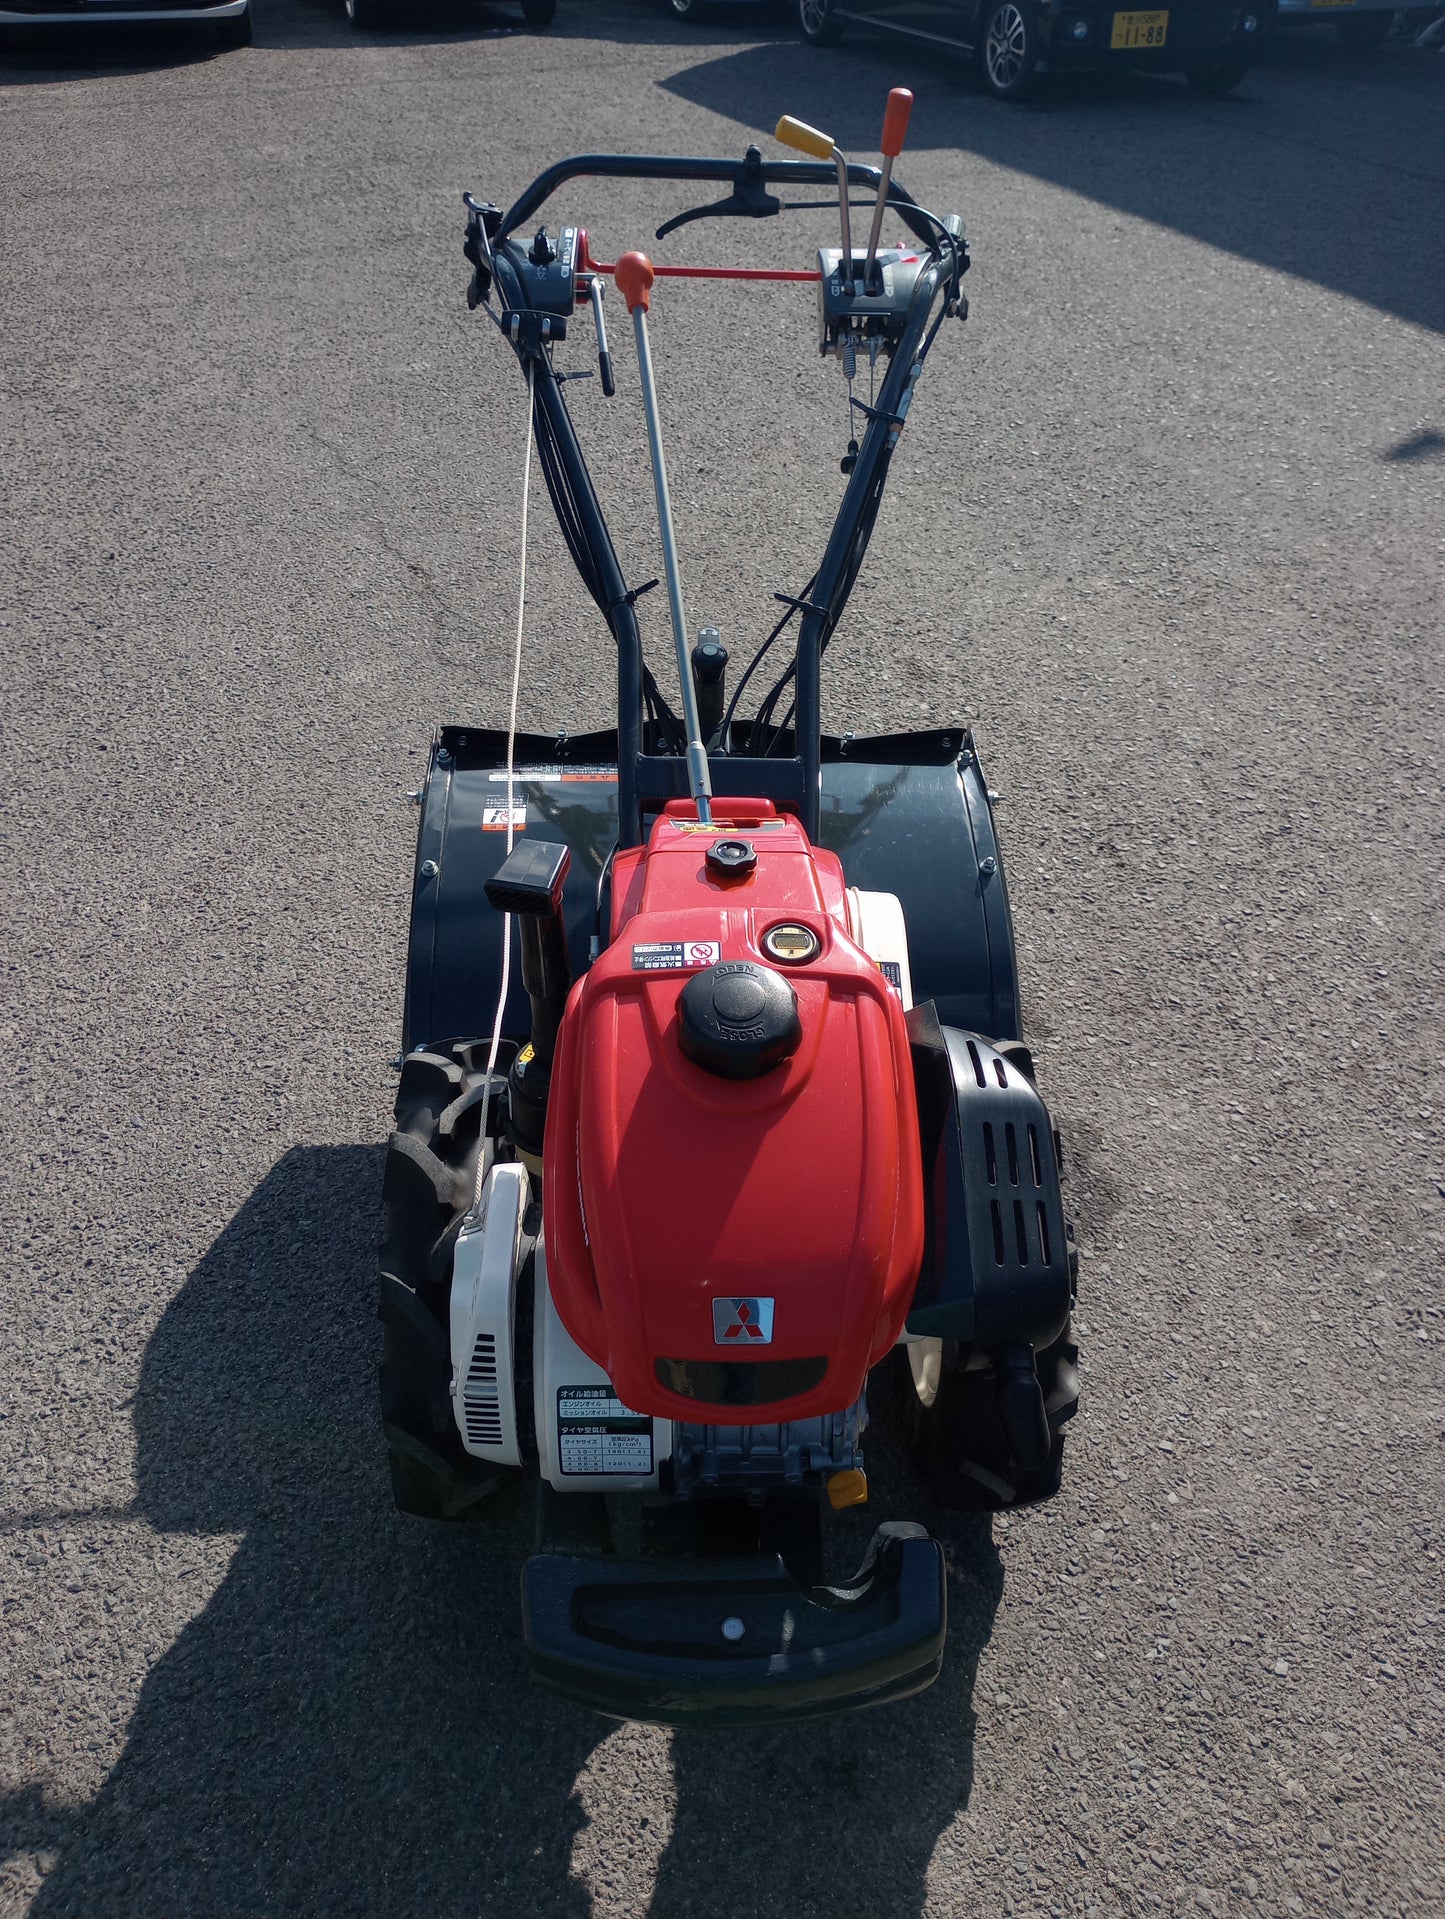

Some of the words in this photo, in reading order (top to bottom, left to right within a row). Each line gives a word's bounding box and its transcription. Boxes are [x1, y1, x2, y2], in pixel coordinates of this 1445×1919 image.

[1125, 26, 1163, 46] 11-88
[716, 964, 755, 975] OPEN
[720, 1027, 767, 1041] CLOSE
[560, 1390, 607, 1398] オイル給油量
